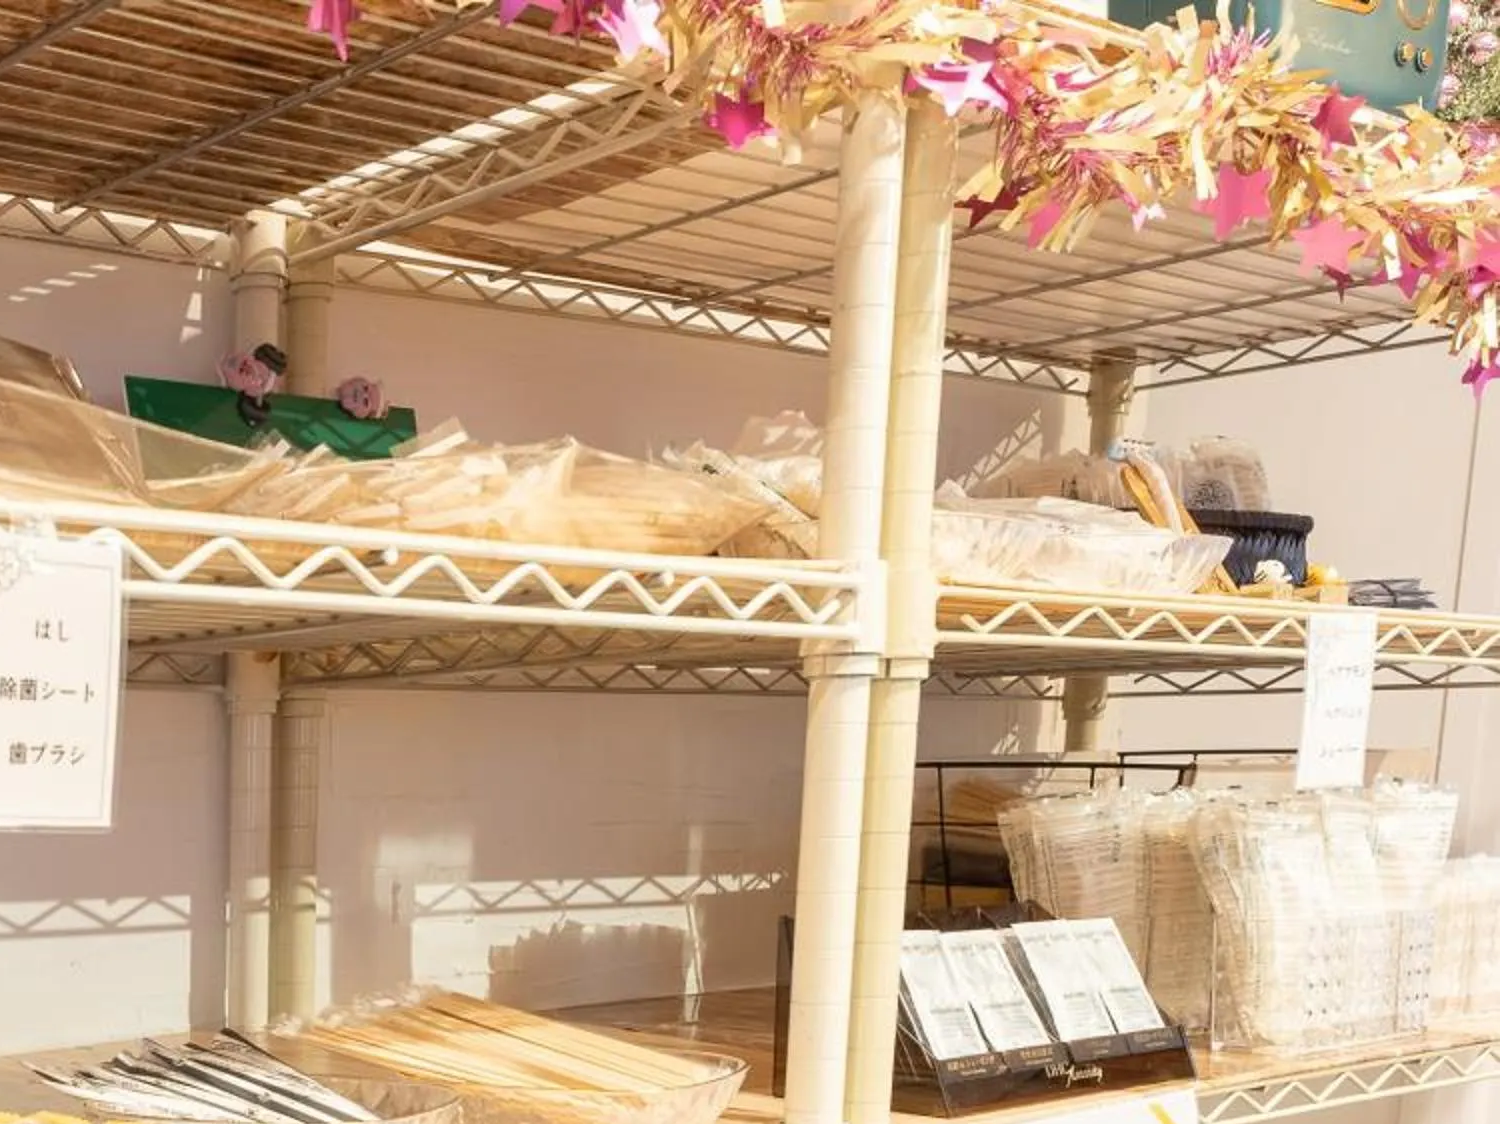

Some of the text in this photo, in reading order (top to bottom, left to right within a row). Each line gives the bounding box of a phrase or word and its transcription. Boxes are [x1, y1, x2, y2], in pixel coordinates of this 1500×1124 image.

[35, 619, 71, 643] はし
[8, 741, 86, 766] 歯ブラシ
